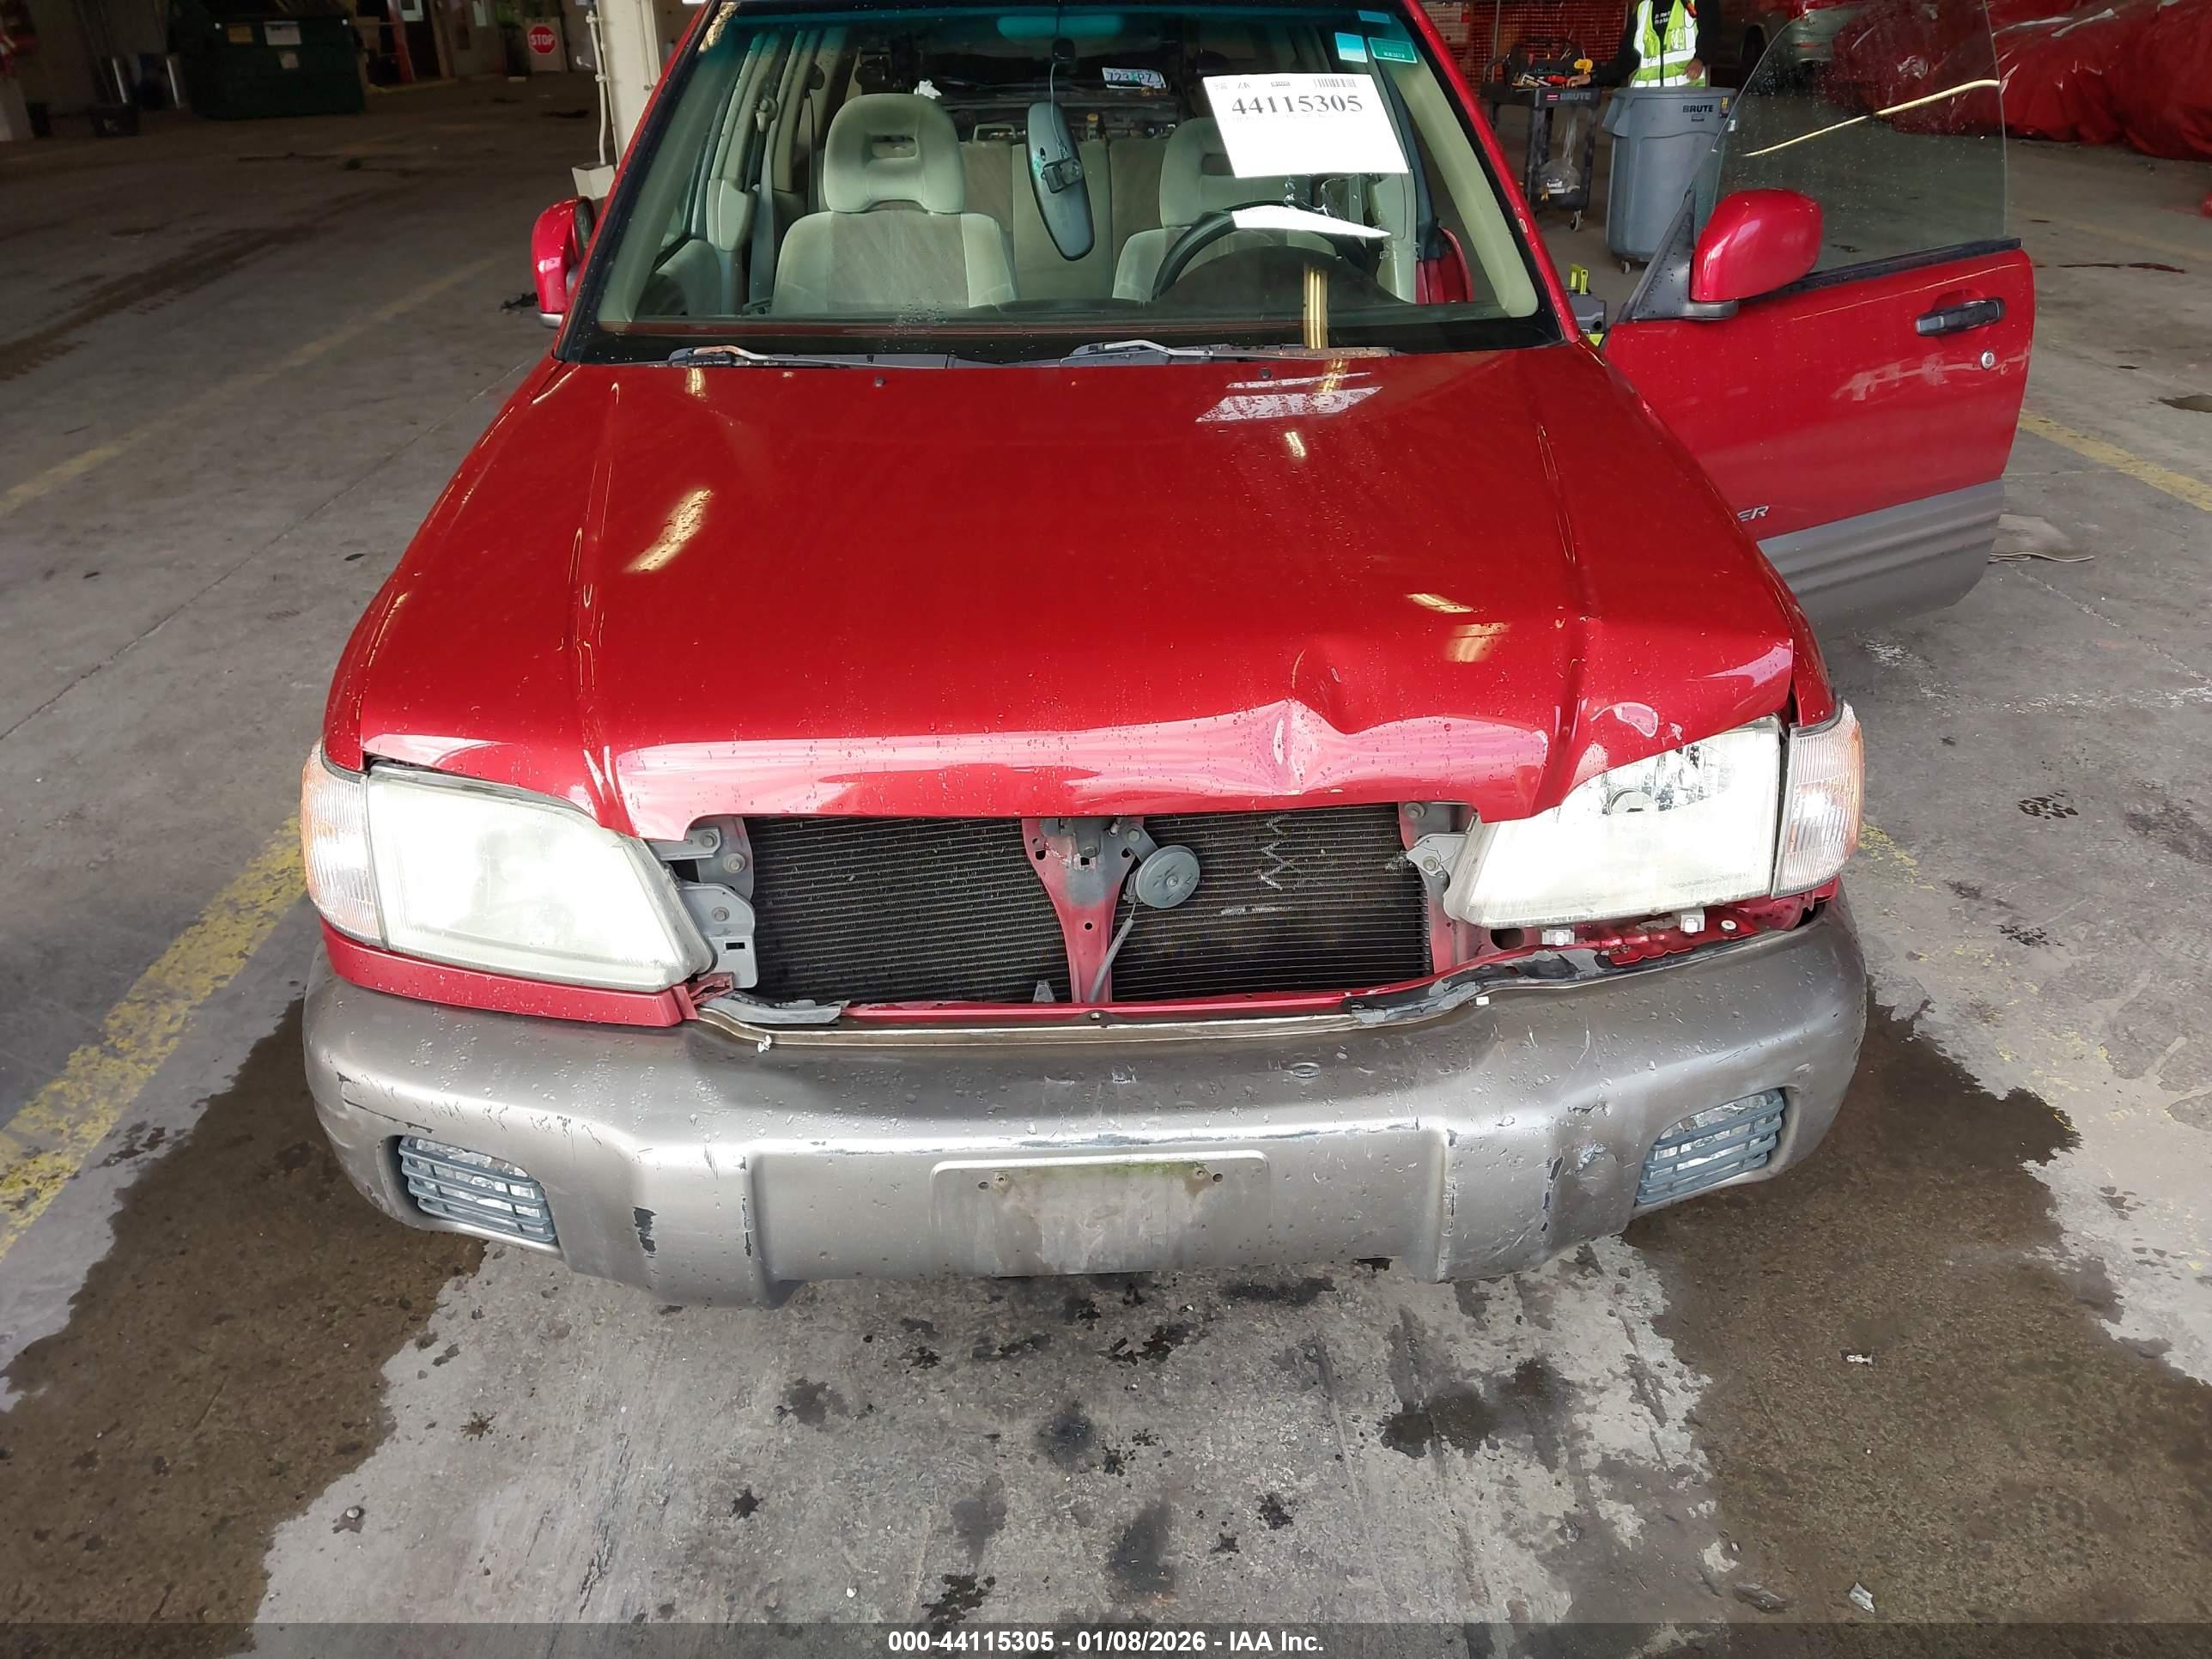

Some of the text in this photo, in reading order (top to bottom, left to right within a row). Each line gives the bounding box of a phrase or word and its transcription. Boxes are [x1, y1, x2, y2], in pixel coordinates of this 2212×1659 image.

[530, 33, 555, 46] STOP
[1559, 92, 1592, 100] BRUTE
[1231, 94, 1363, 114] 44115305
[1682, 104, 1715, 113] BRUTE
[1737, 505, 1770, 522] ER
